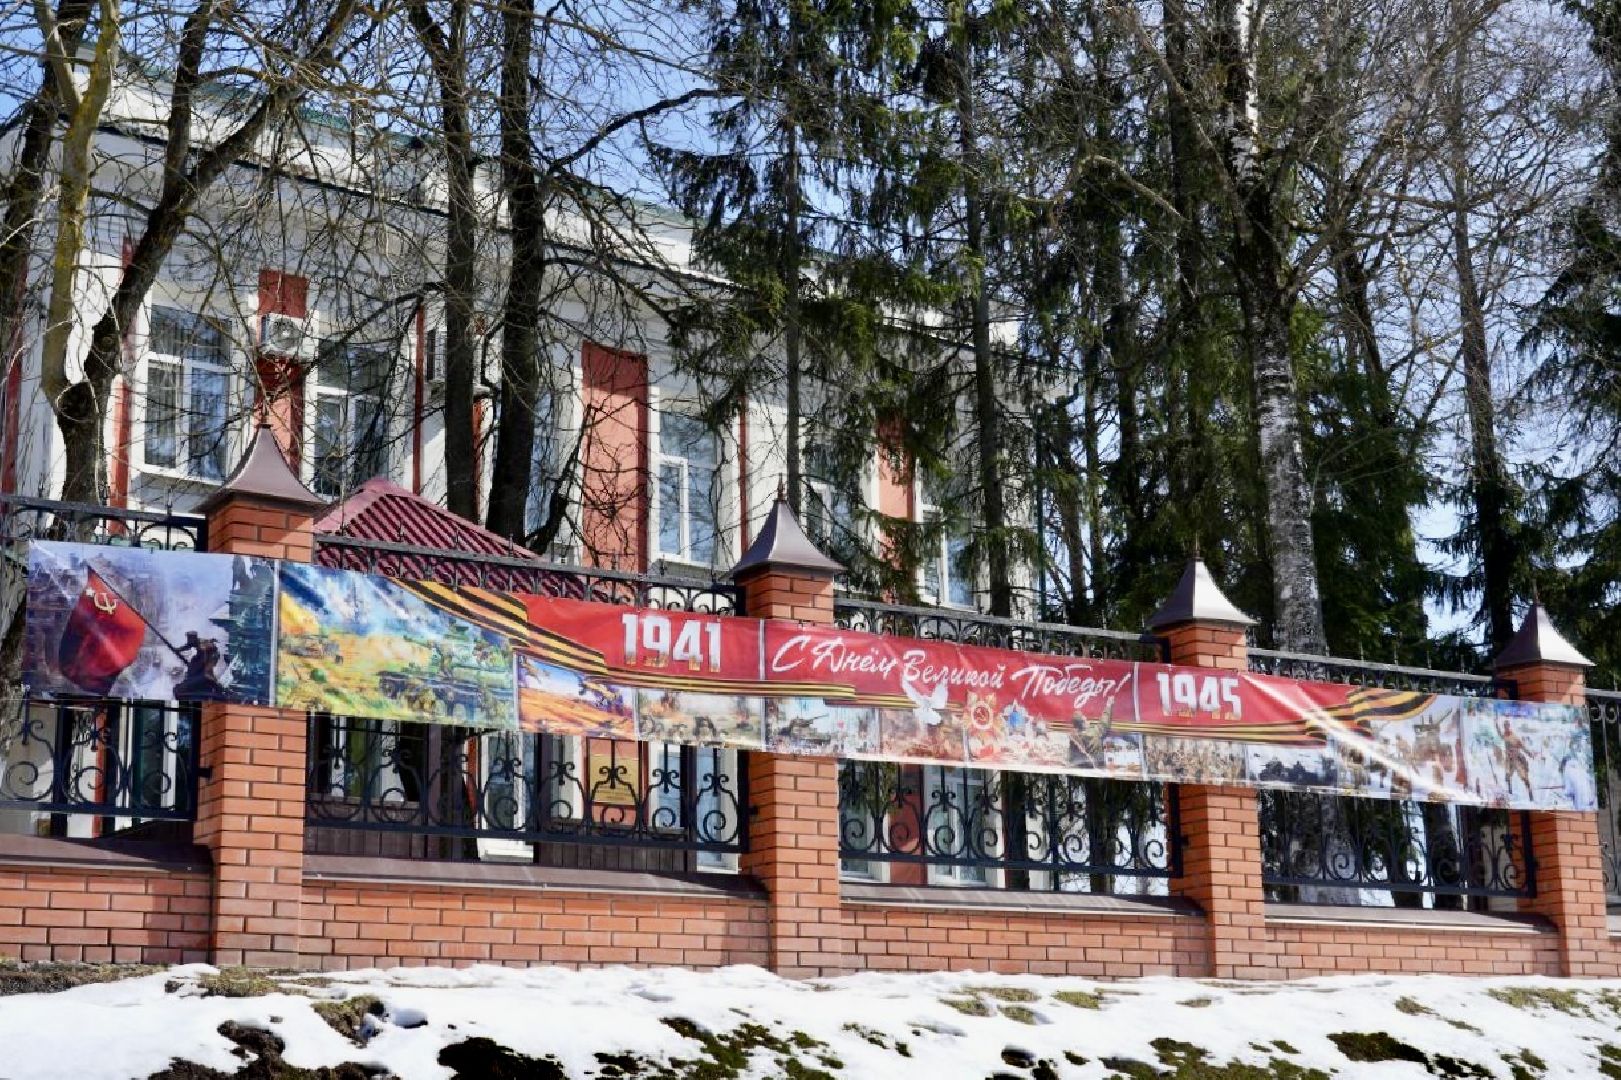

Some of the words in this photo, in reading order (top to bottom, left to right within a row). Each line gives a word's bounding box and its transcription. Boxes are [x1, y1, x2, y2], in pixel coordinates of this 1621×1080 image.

[622, 613, 721, 672] 1941
[772, 635, 811, 672] С
[811, 637, 899, 680] Днём
[902, 650, 1006, 688] Великой
[1010, 663, 1131, 708] Победы!
[1156, 672, 1242, 720] 1945
